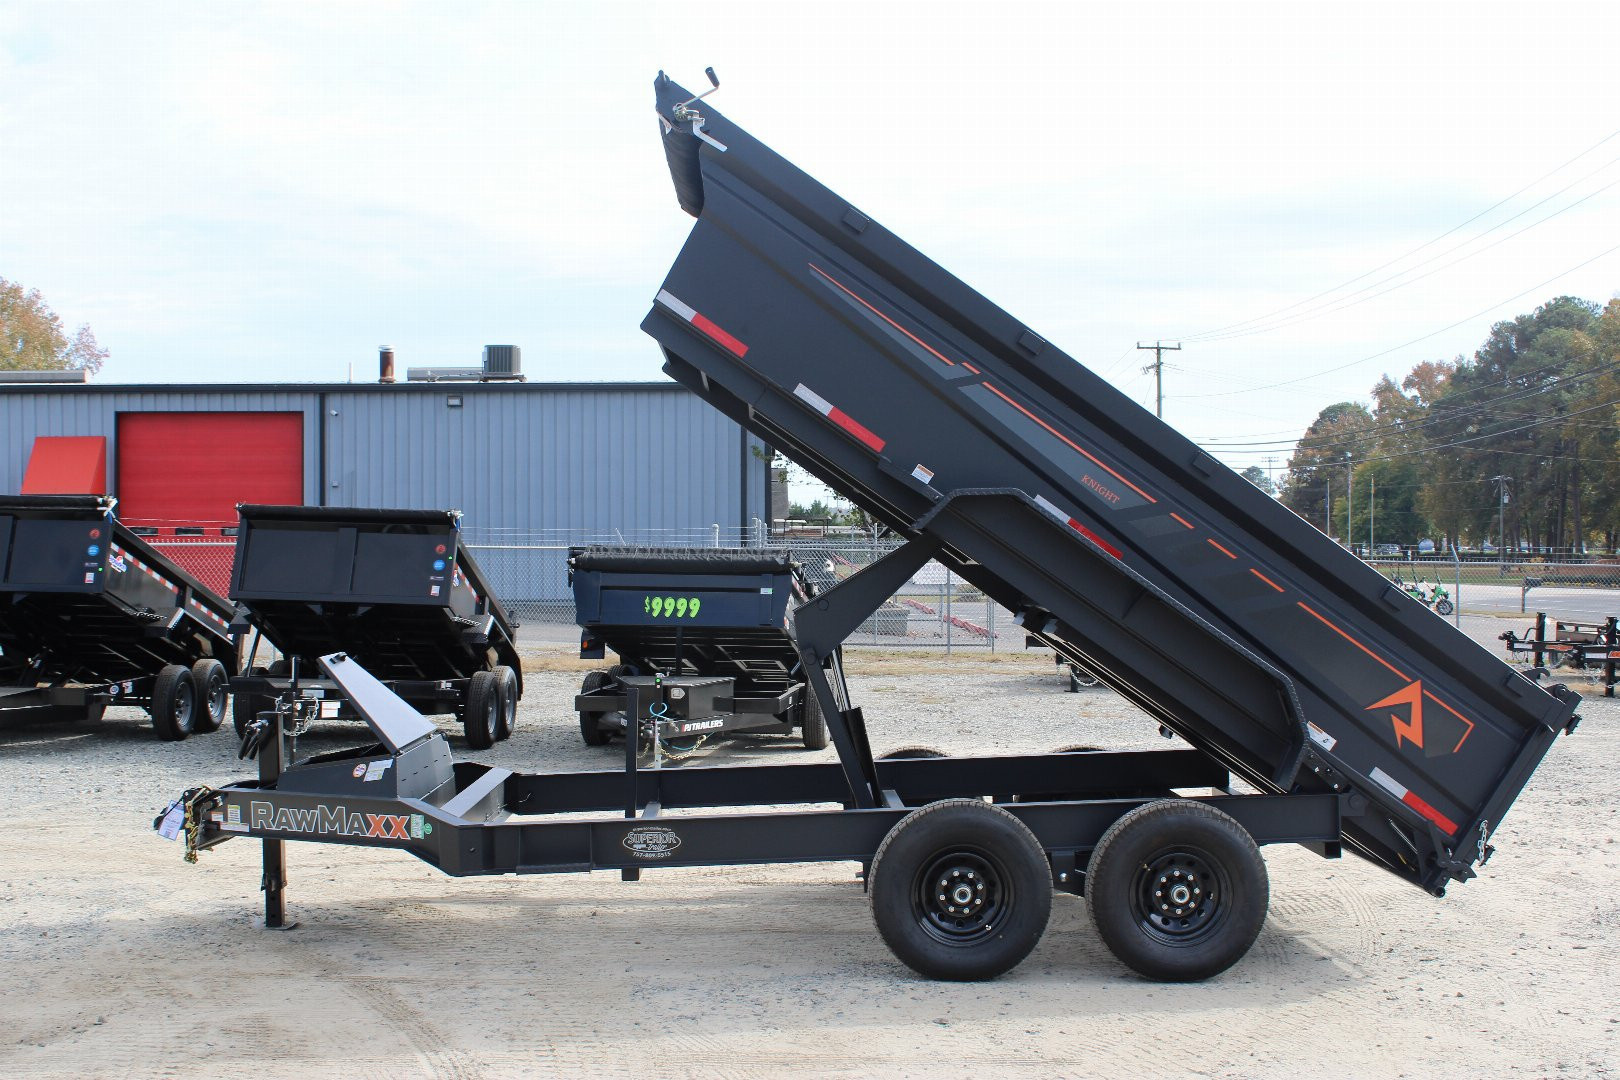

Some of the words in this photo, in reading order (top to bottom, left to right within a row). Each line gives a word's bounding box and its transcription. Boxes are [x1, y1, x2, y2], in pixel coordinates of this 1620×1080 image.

[1082, 474, 1120, 503] KNIGHT
[644, 596, 701, 618] $9999
[692, 719, 724, 731] TRAILERS
[628, 833, 676, 844] SUPERIOR
